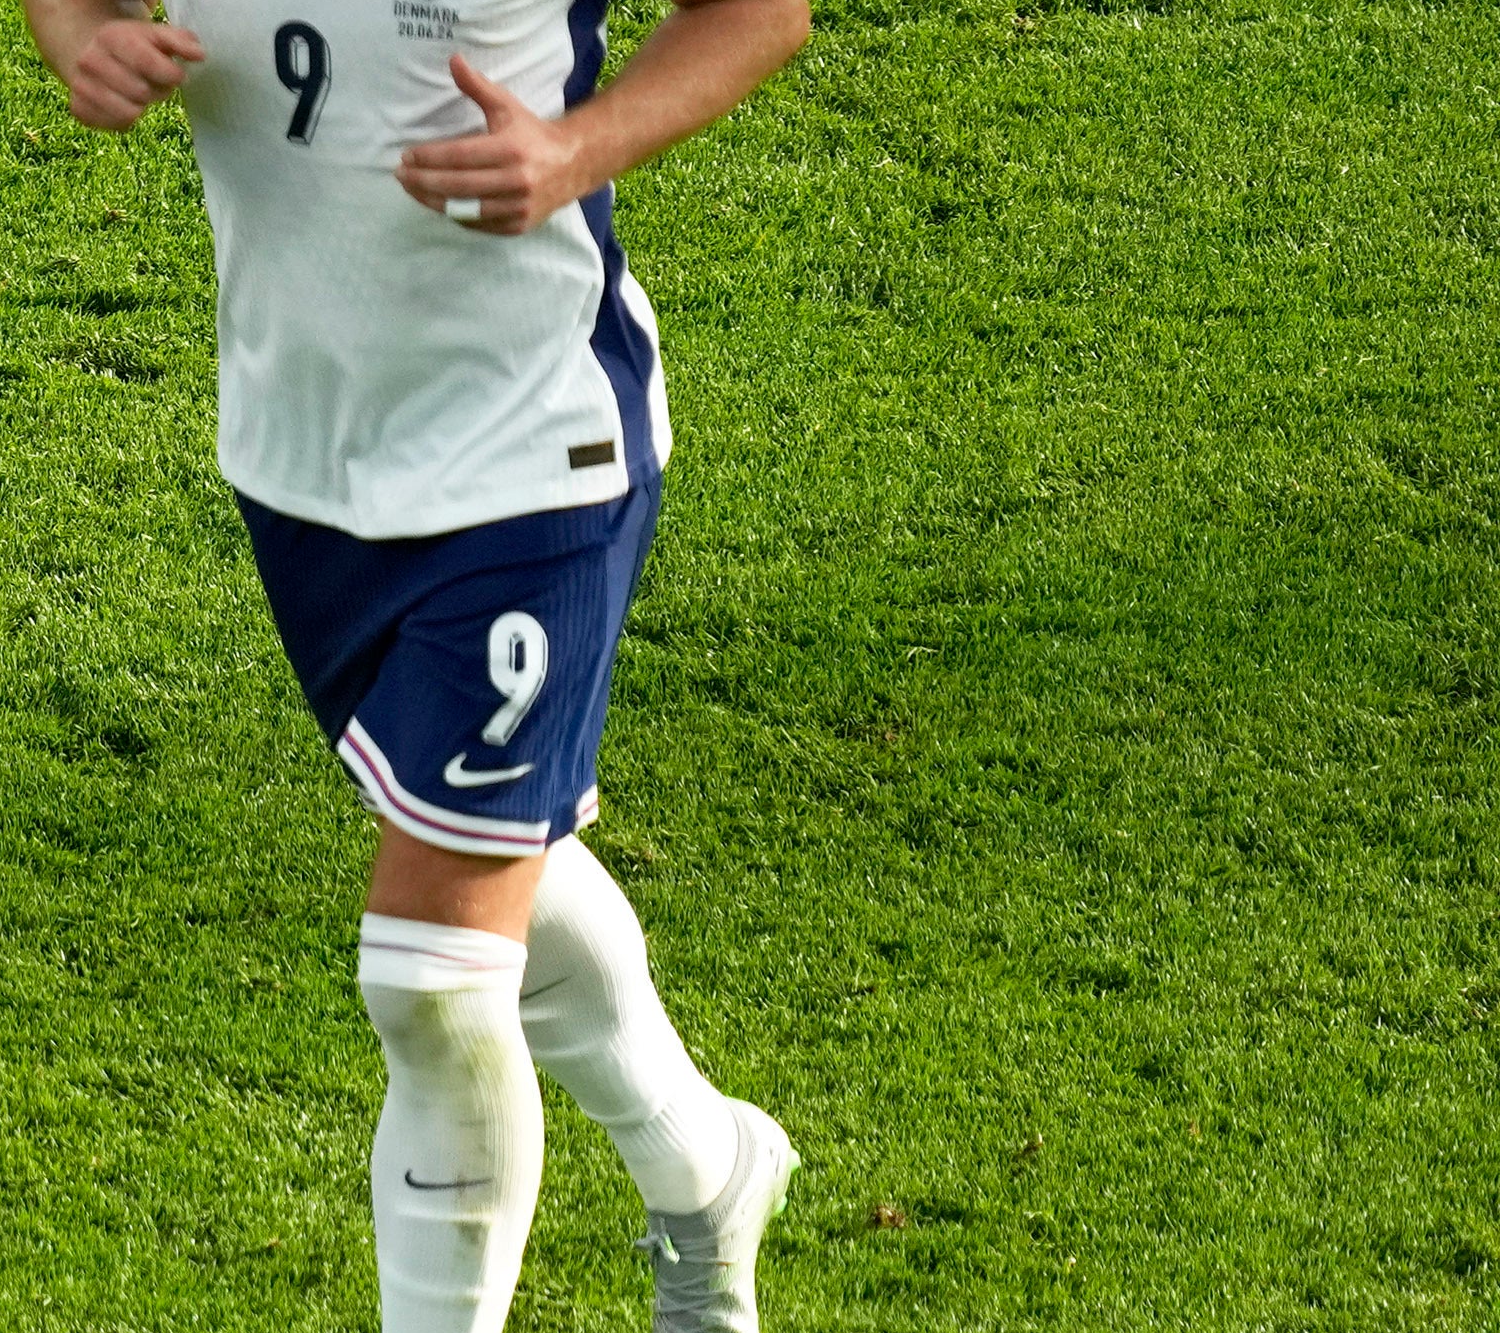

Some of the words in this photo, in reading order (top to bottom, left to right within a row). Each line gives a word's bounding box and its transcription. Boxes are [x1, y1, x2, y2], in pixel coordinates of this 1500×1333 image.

[394, 0, 460, 24] DENMARK
[274, 20, 332, 145] 9
[481, 611, 549, 747] 9
